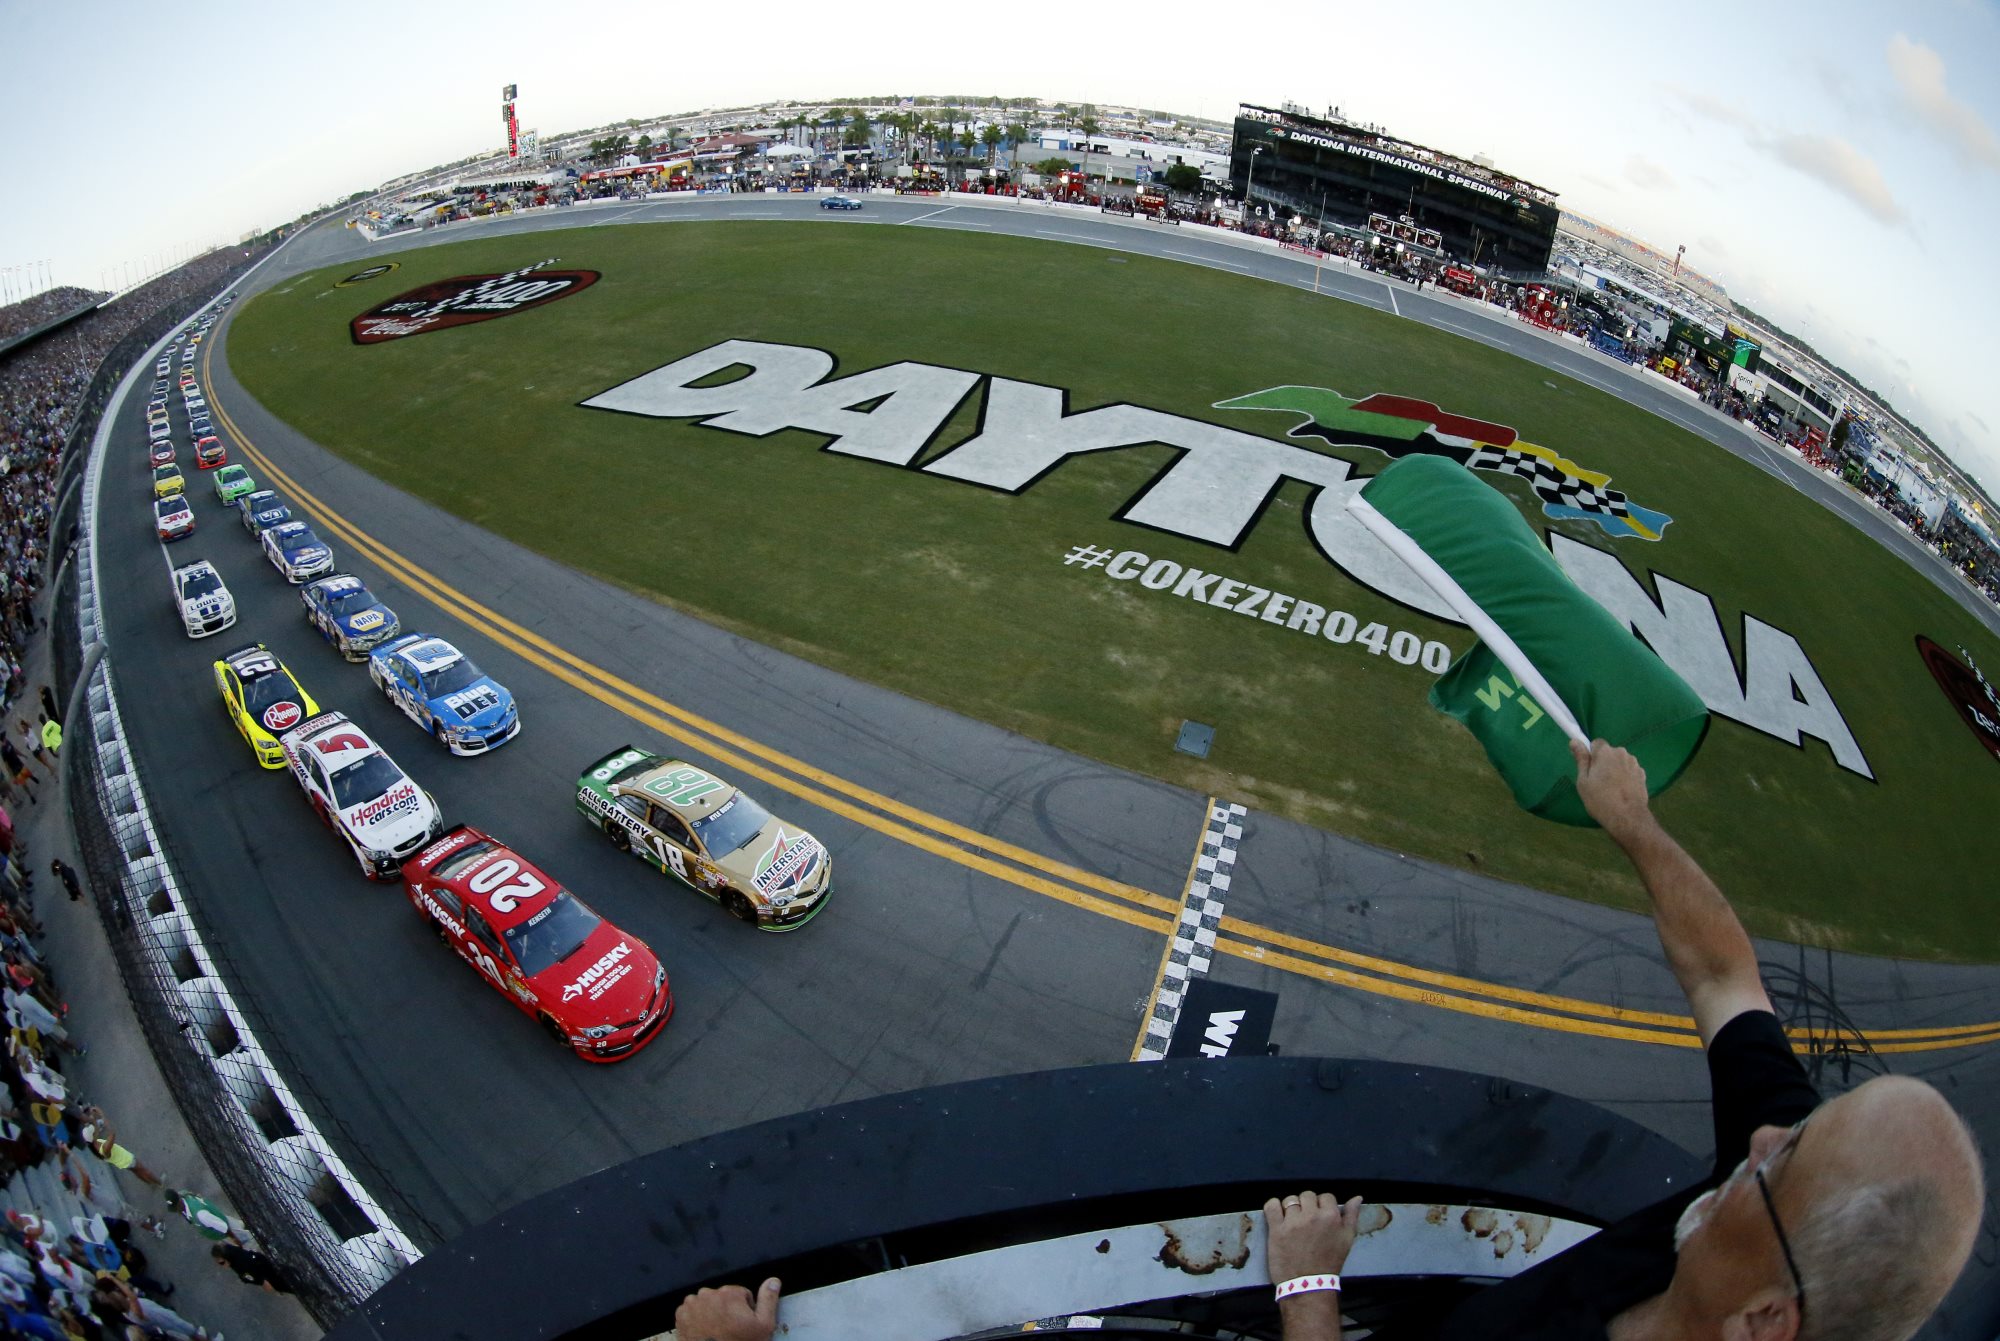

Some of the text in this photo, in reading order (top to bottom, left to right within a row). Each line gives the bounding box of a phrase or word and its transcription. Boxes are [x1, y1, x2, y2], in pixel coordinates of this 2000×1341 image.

[1290, 131, 1512, 201] DAYTONA INTERNATIONAL SPEEDWAY
[1737, 372, 1754, 387] Sprint
[163, 511, 188, 525] 3M
[354, 612, 380, 627] NAPA
[1063, 543, 1452, 675] #COKEZERO400
[266, 705, 300, 728] Rheem
[454, 692, 499, 720] DEF
[643, 767, 725, 807] 18
[351, 784, 414, 828] Hendrick
[369, 794, 417, 826] cars.com
[581, 787, 650, 837] ALL BATTERY
[709, 808, 722, 822] KYLE
[382, 859, 389, 867] 5
[419, 838, 455, 867] HUSKY
[653, 836, 688, 878] 18
[755, 836, 814, 889] INTERSTATE
[455, 853, 491, 882] HUSKY
[766, 881, 779, 894] ALL
[777, 860, 801, 883] BATTERY
[468, 858, 548, 914] 20
[424, 893, 466, 940] HUSKY
[528, 906, 552, 927] KENSETH
[780, 907, 790, 916] 18
[576, 941, 632, 988] HUSKY
[589, 987, 605, 1001] THAT
[596, 1040, 607, 1048] 20
